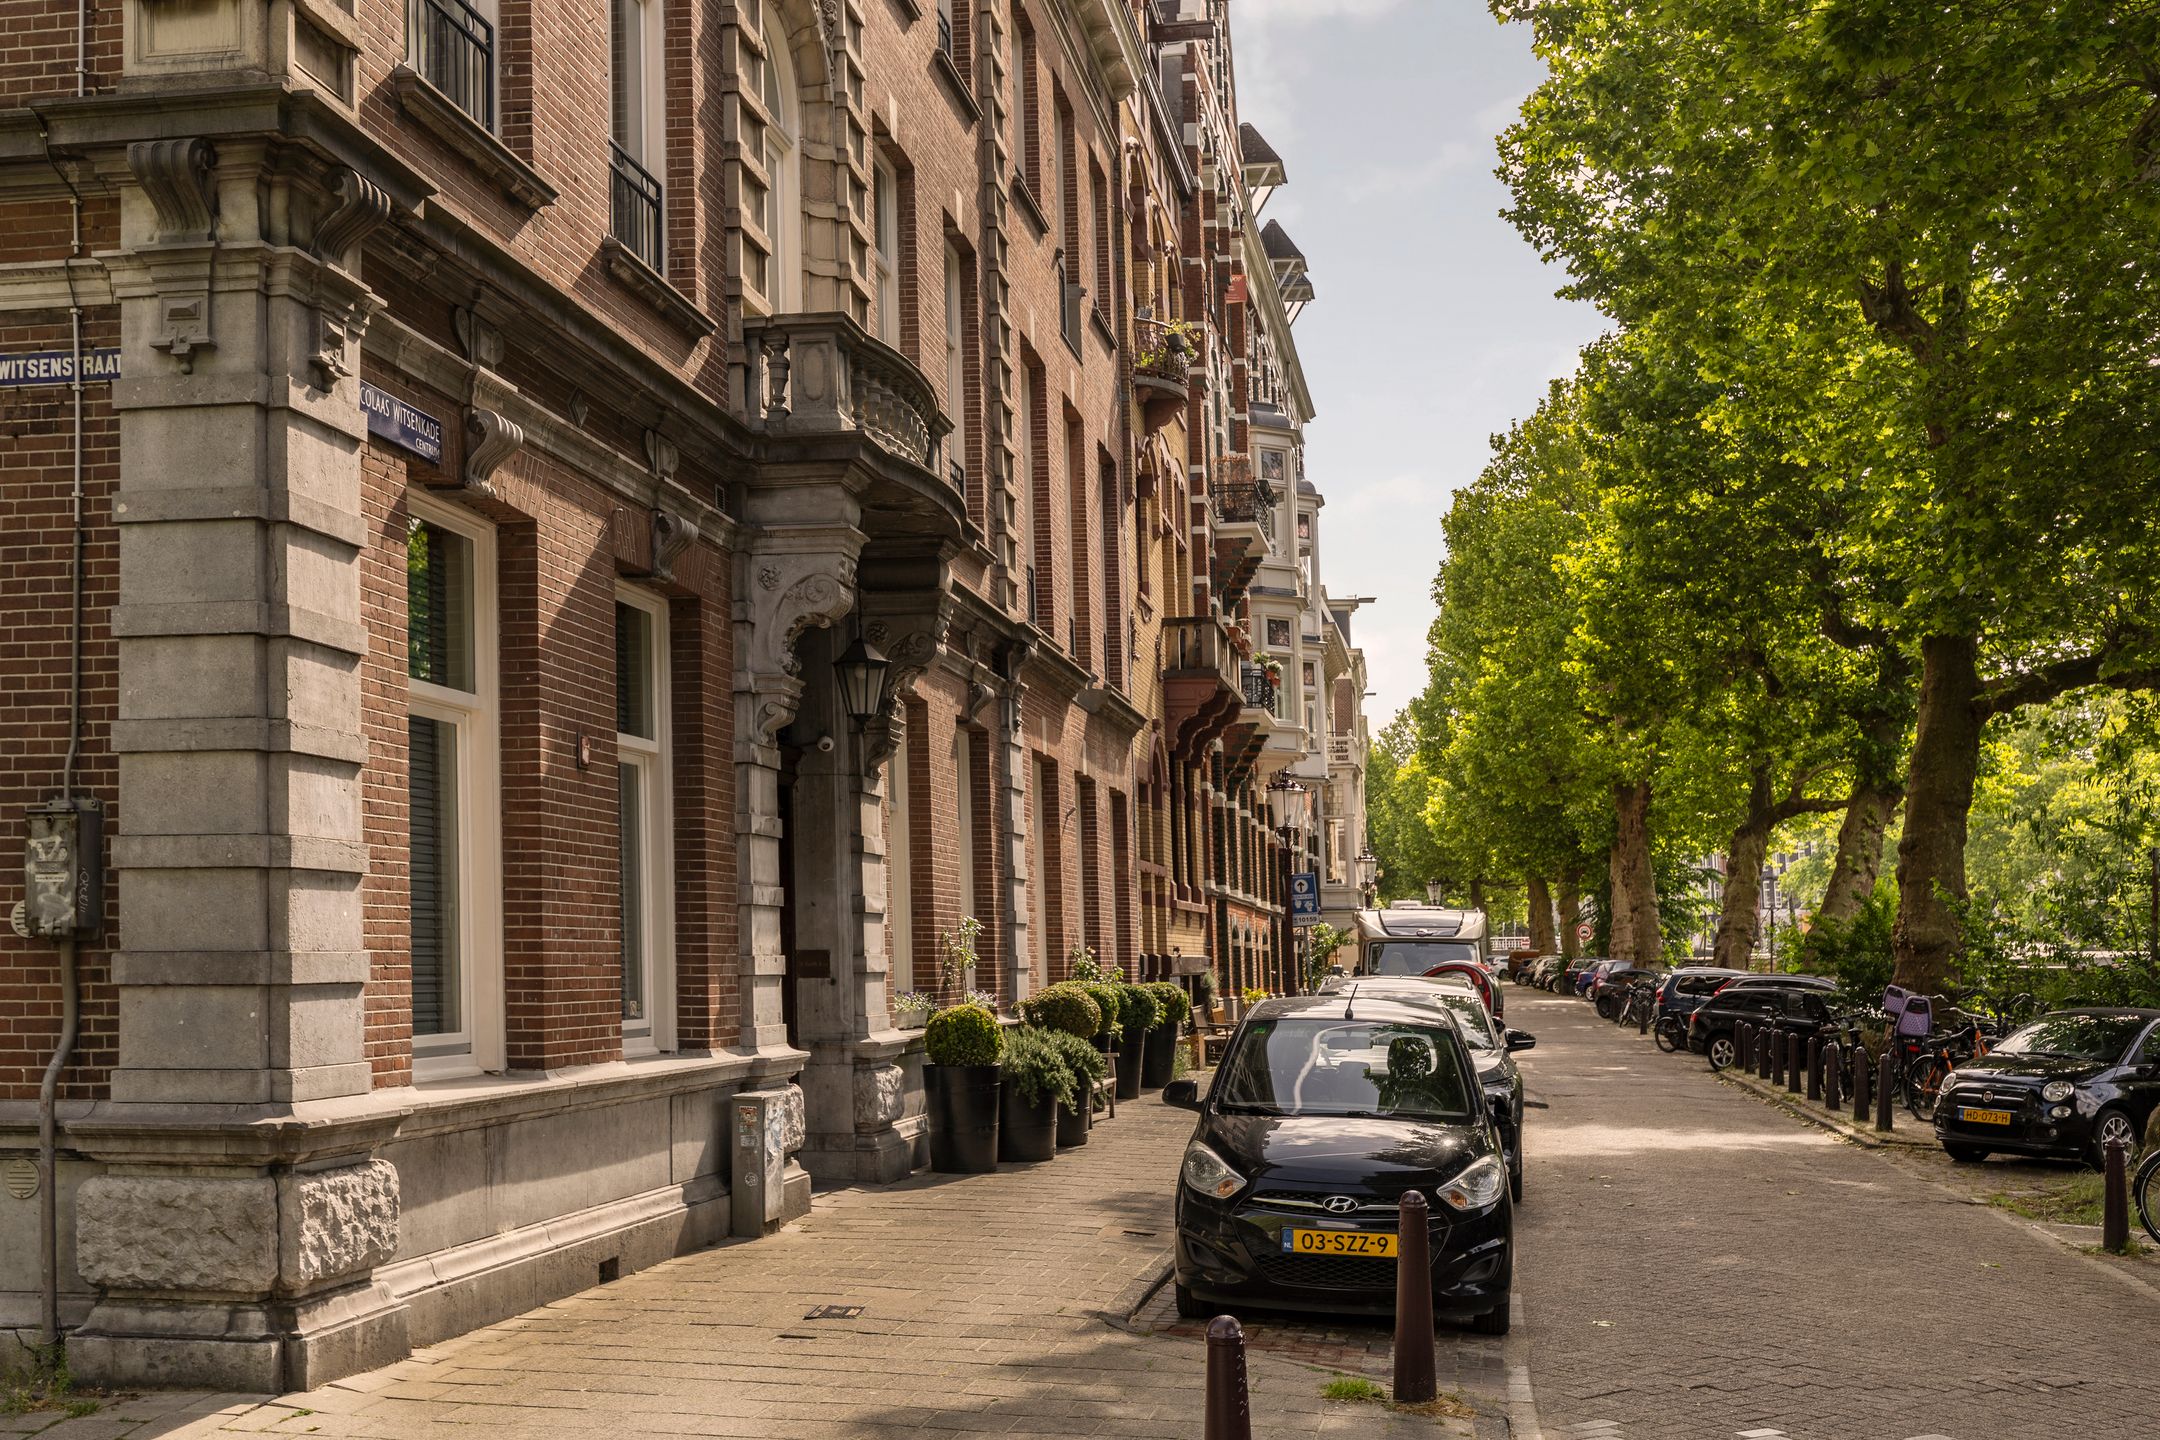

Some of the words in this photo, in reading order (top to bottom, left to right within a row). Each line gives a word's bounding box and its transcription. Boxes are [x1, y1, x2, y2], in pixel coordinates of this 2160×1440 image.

[0, 354, 121, 379] WITSENSRAAT
[392, 402, 440, 443] WITSENKADE
[415, 438, 440, 458] CENTRUM
[1301, 1233, 1389, 1253] 03-SZZ-9
